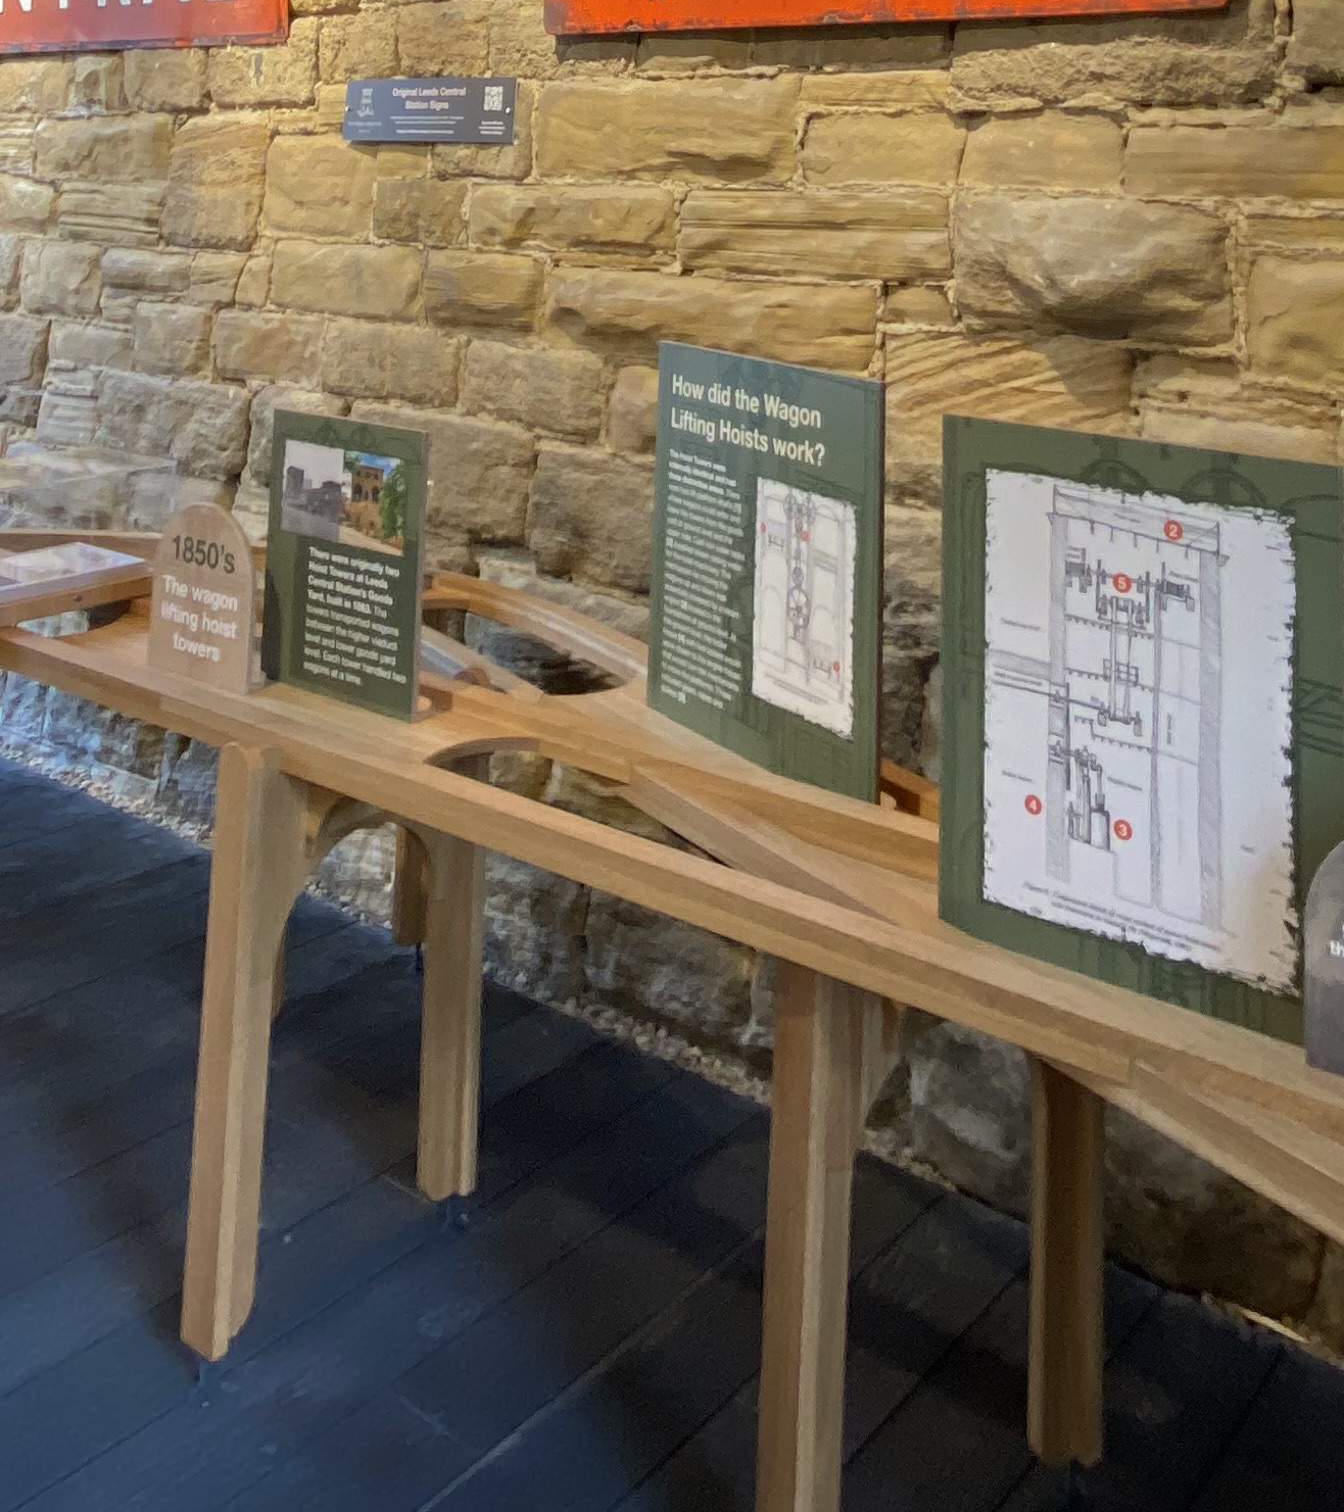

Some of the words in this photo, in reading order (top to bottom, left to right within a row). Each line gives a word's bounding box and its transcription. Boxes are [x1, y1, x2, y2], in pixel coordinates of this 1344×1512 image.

[405, 100, 429, 110] Station
[440, 86, 467, 96] Central
[672, 374, 704, 400] How
[708, 383, 730, 407] did
[735, 388, 759, 414] the
[764, 394, 821, 429] Wagon
[671, 407, 715, 443] Lifting
[719, 419, 768, 452] Hoists
[773, 438, 825, 467] work?
[173, 535, 235, 574] 1850's
[163, 574, 188, 598] The
[191, 586, 238, 612] wagon
[161, 601, 198, 632] lifting
[201, 612, 237, 640] hoist
[173, 632, 220, 662] towers
